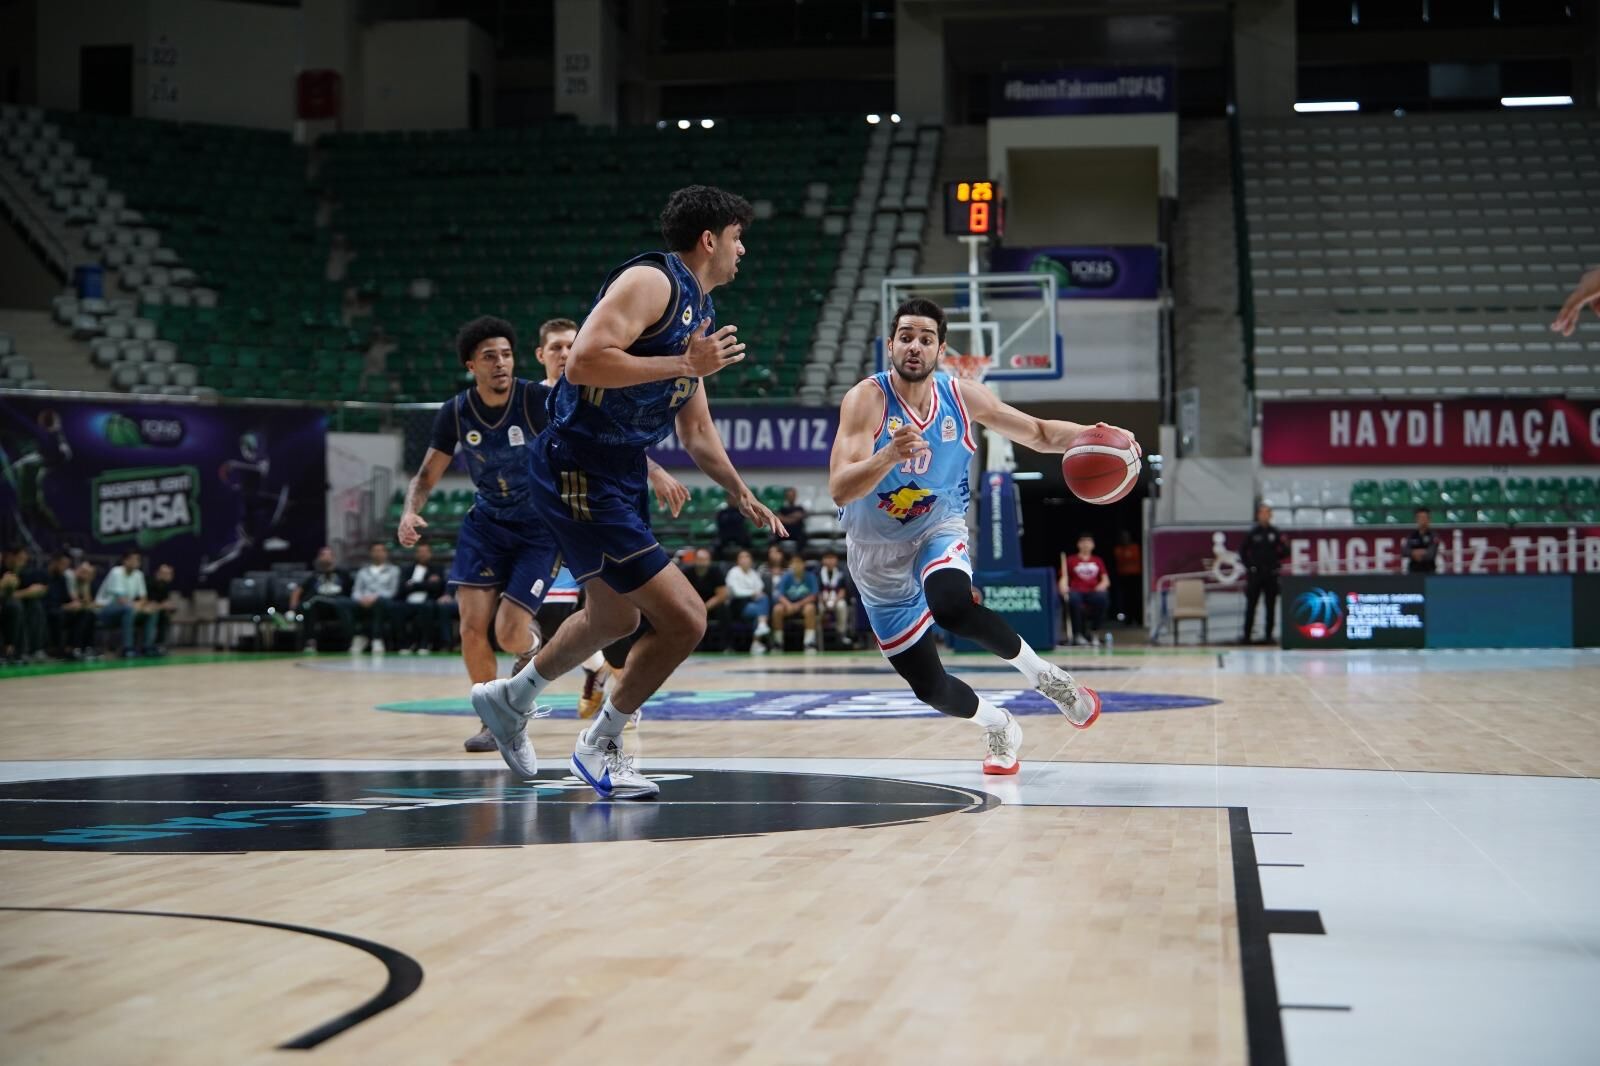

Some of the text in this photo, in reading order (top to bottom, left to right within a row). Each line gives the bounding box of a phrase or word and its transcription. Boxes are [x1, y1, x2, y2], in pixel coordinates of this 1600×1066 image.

[970, 202, 989, 232] 8
[1329, 402, 1443, 447] HAYDİ
[1463, 409, 1570, 456] MAÇA
[101, 492, 190, 533] BURSA
[1290, 529, 1488, 574] ENGEİZ
